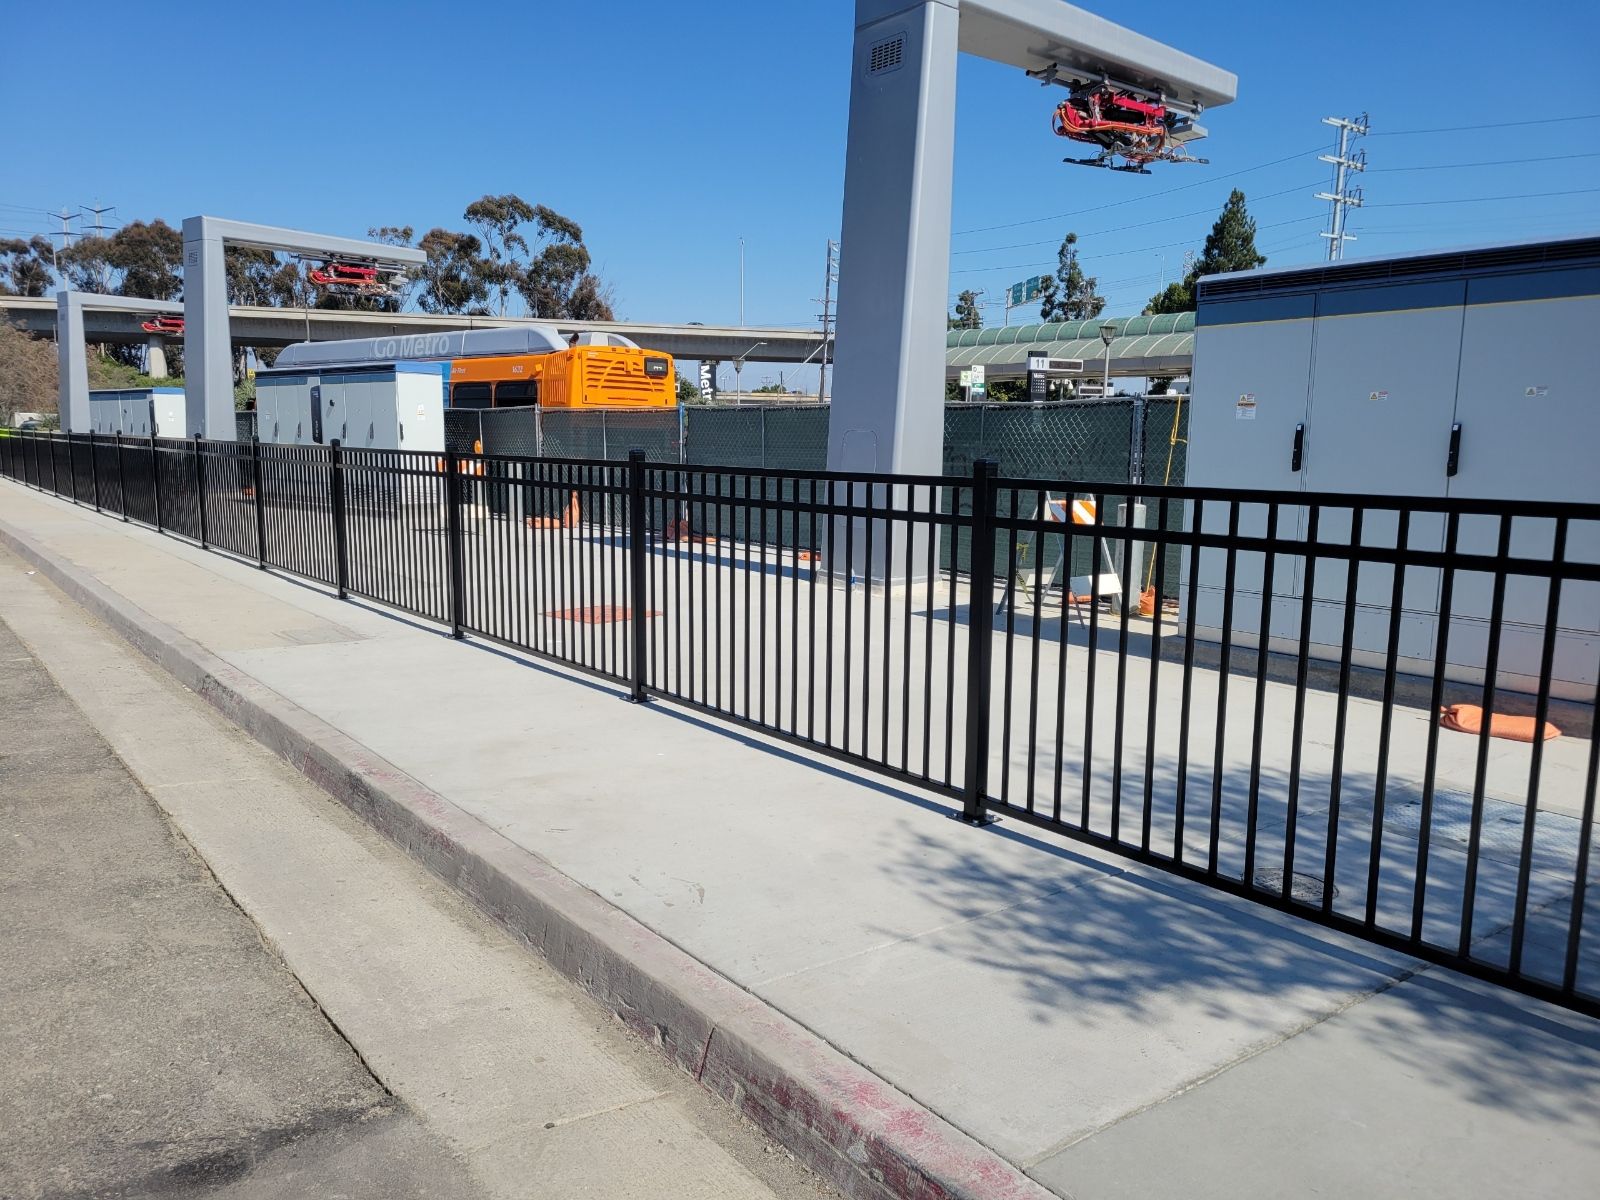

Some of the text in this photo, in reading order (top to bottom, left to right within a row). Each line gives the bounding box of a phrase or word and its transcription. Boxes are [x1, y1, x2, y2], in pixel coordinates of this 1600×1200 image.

[375, 335, 450, 358] Go Metro
[1036, 359, 1045, 368] 11
[701, 364, 714, 404] Metr
